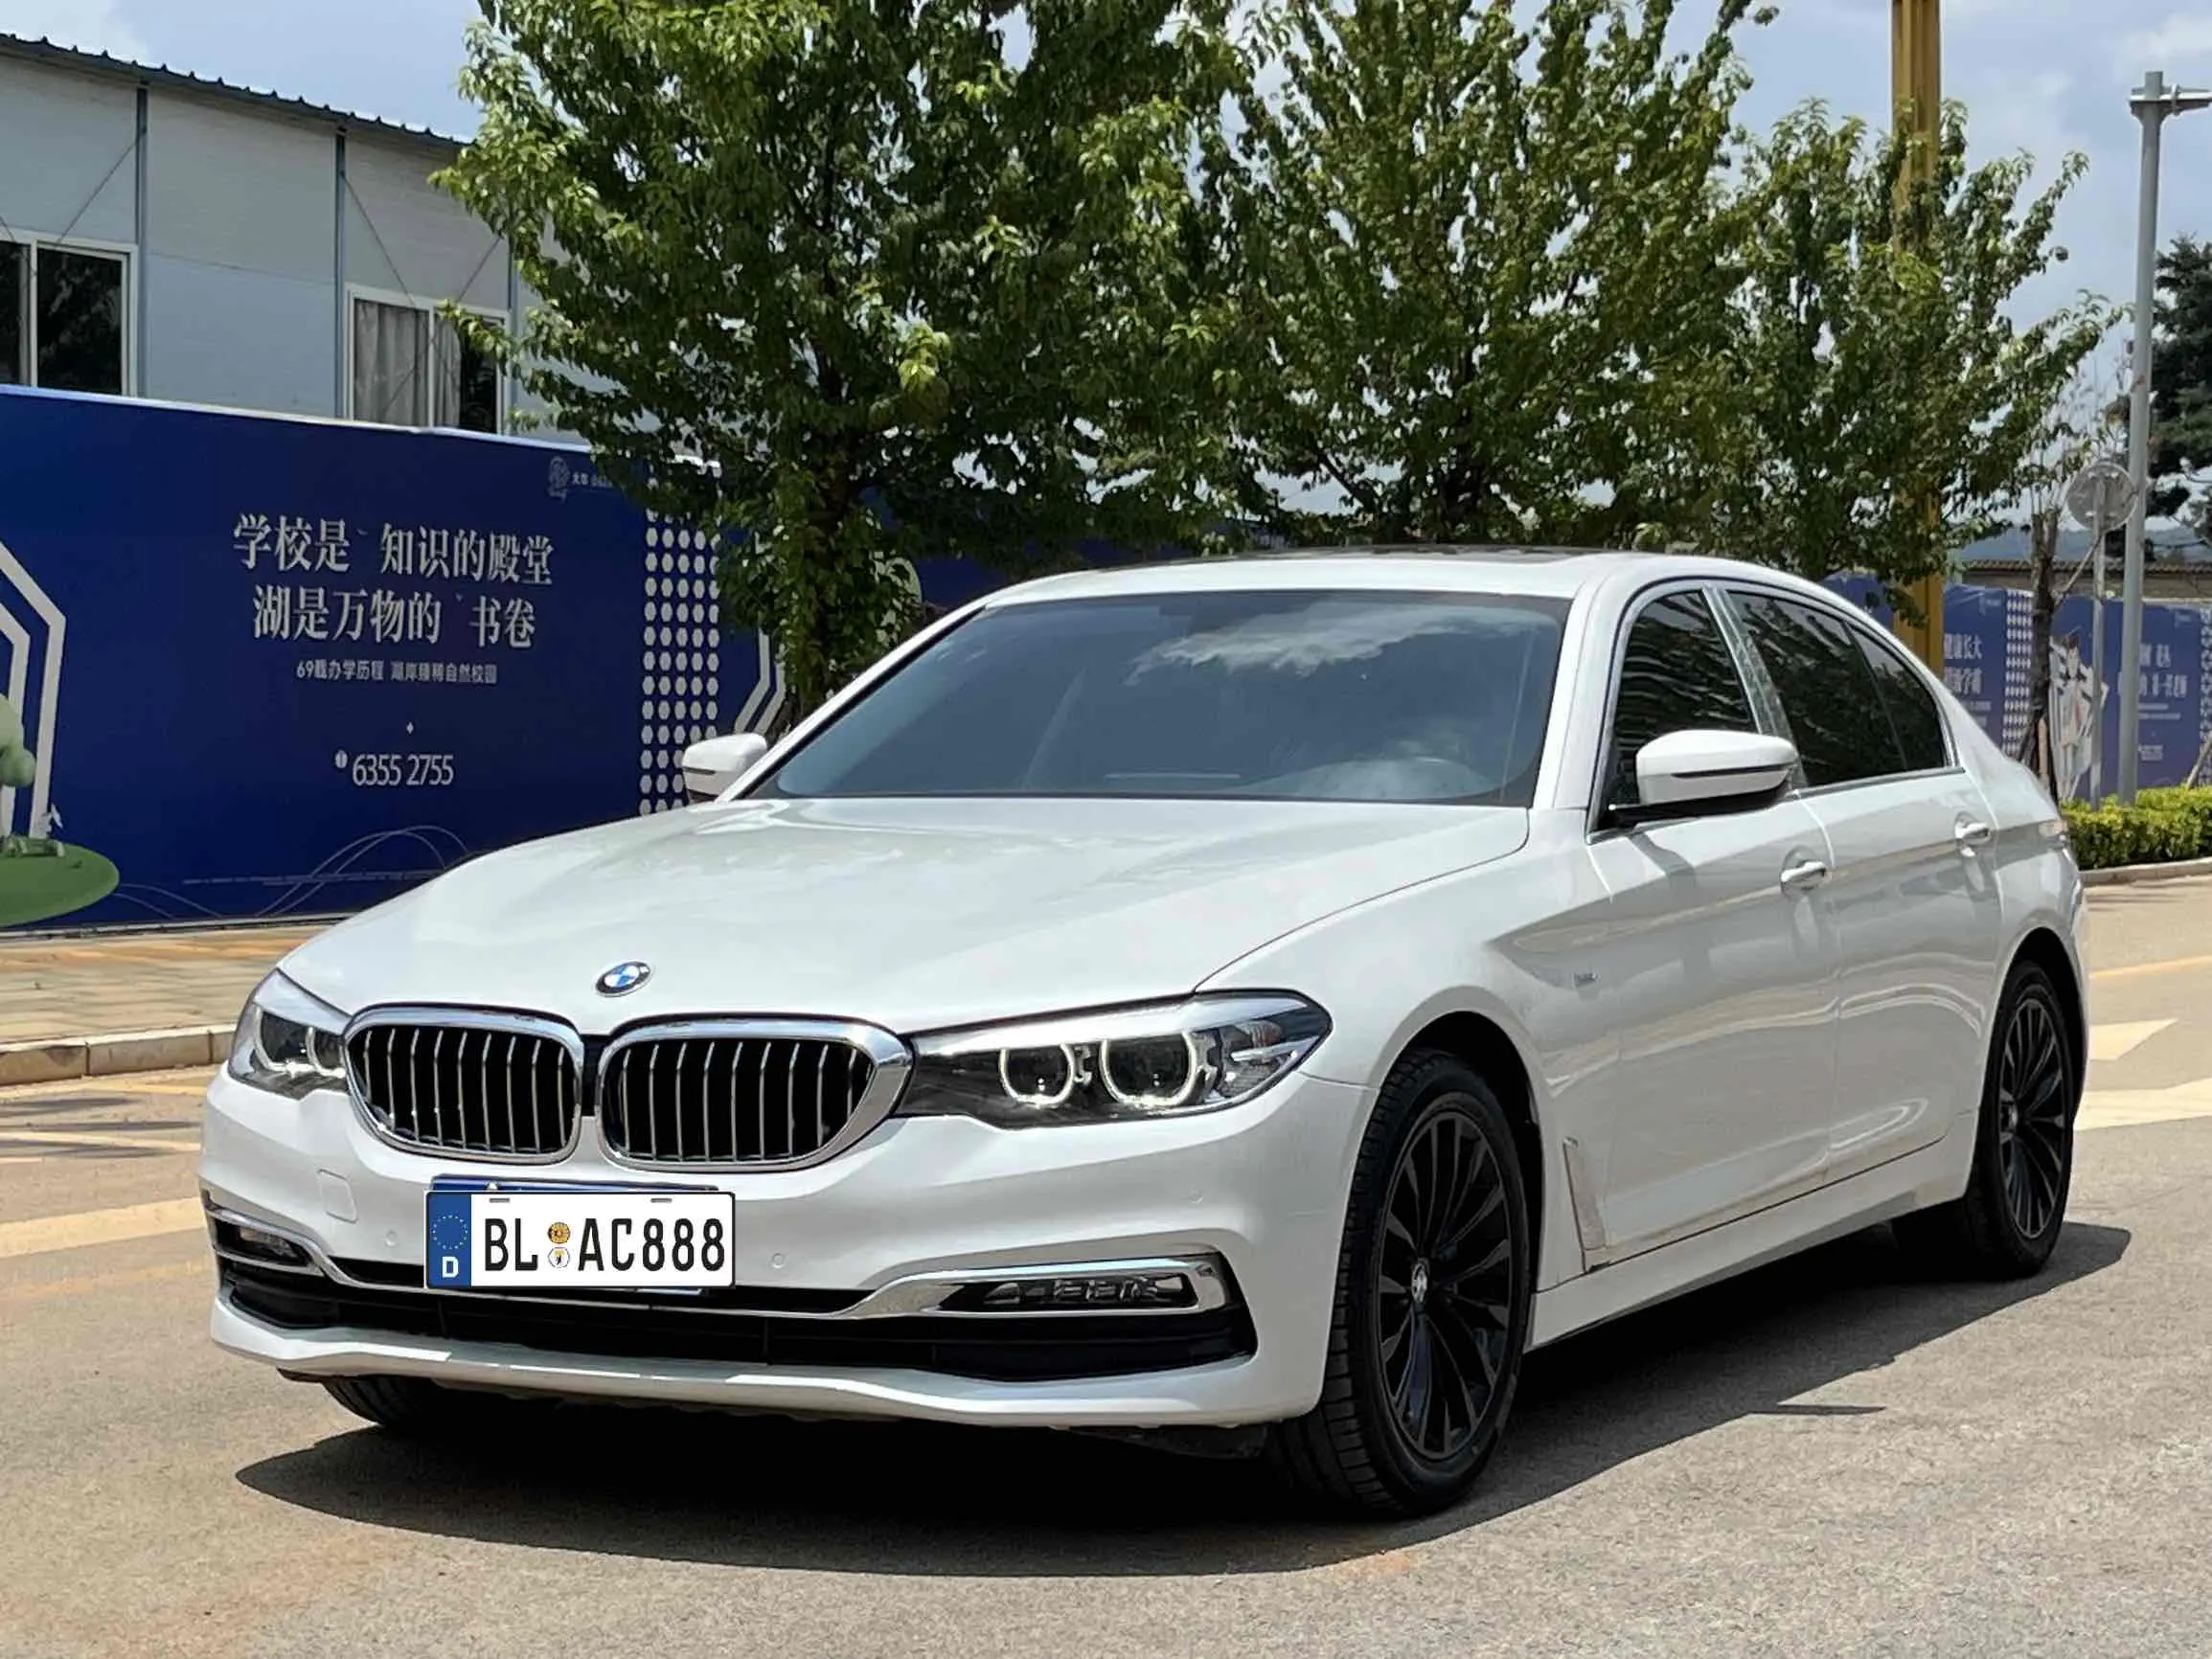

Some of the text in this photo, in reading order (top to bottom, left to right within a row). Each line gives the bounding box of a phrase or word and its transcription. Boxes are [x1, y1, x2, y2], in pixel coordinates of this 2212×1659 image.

[233, 513, 554, 585] 学校是 知识的殿堂
[252, 584, 536, 648] 湖是万物的 书卷
[352, 754, 454, 786] 6355 2755
[442, 1256, 459, 1279] D
[485, 1217, 725, 1272] BL AC888
